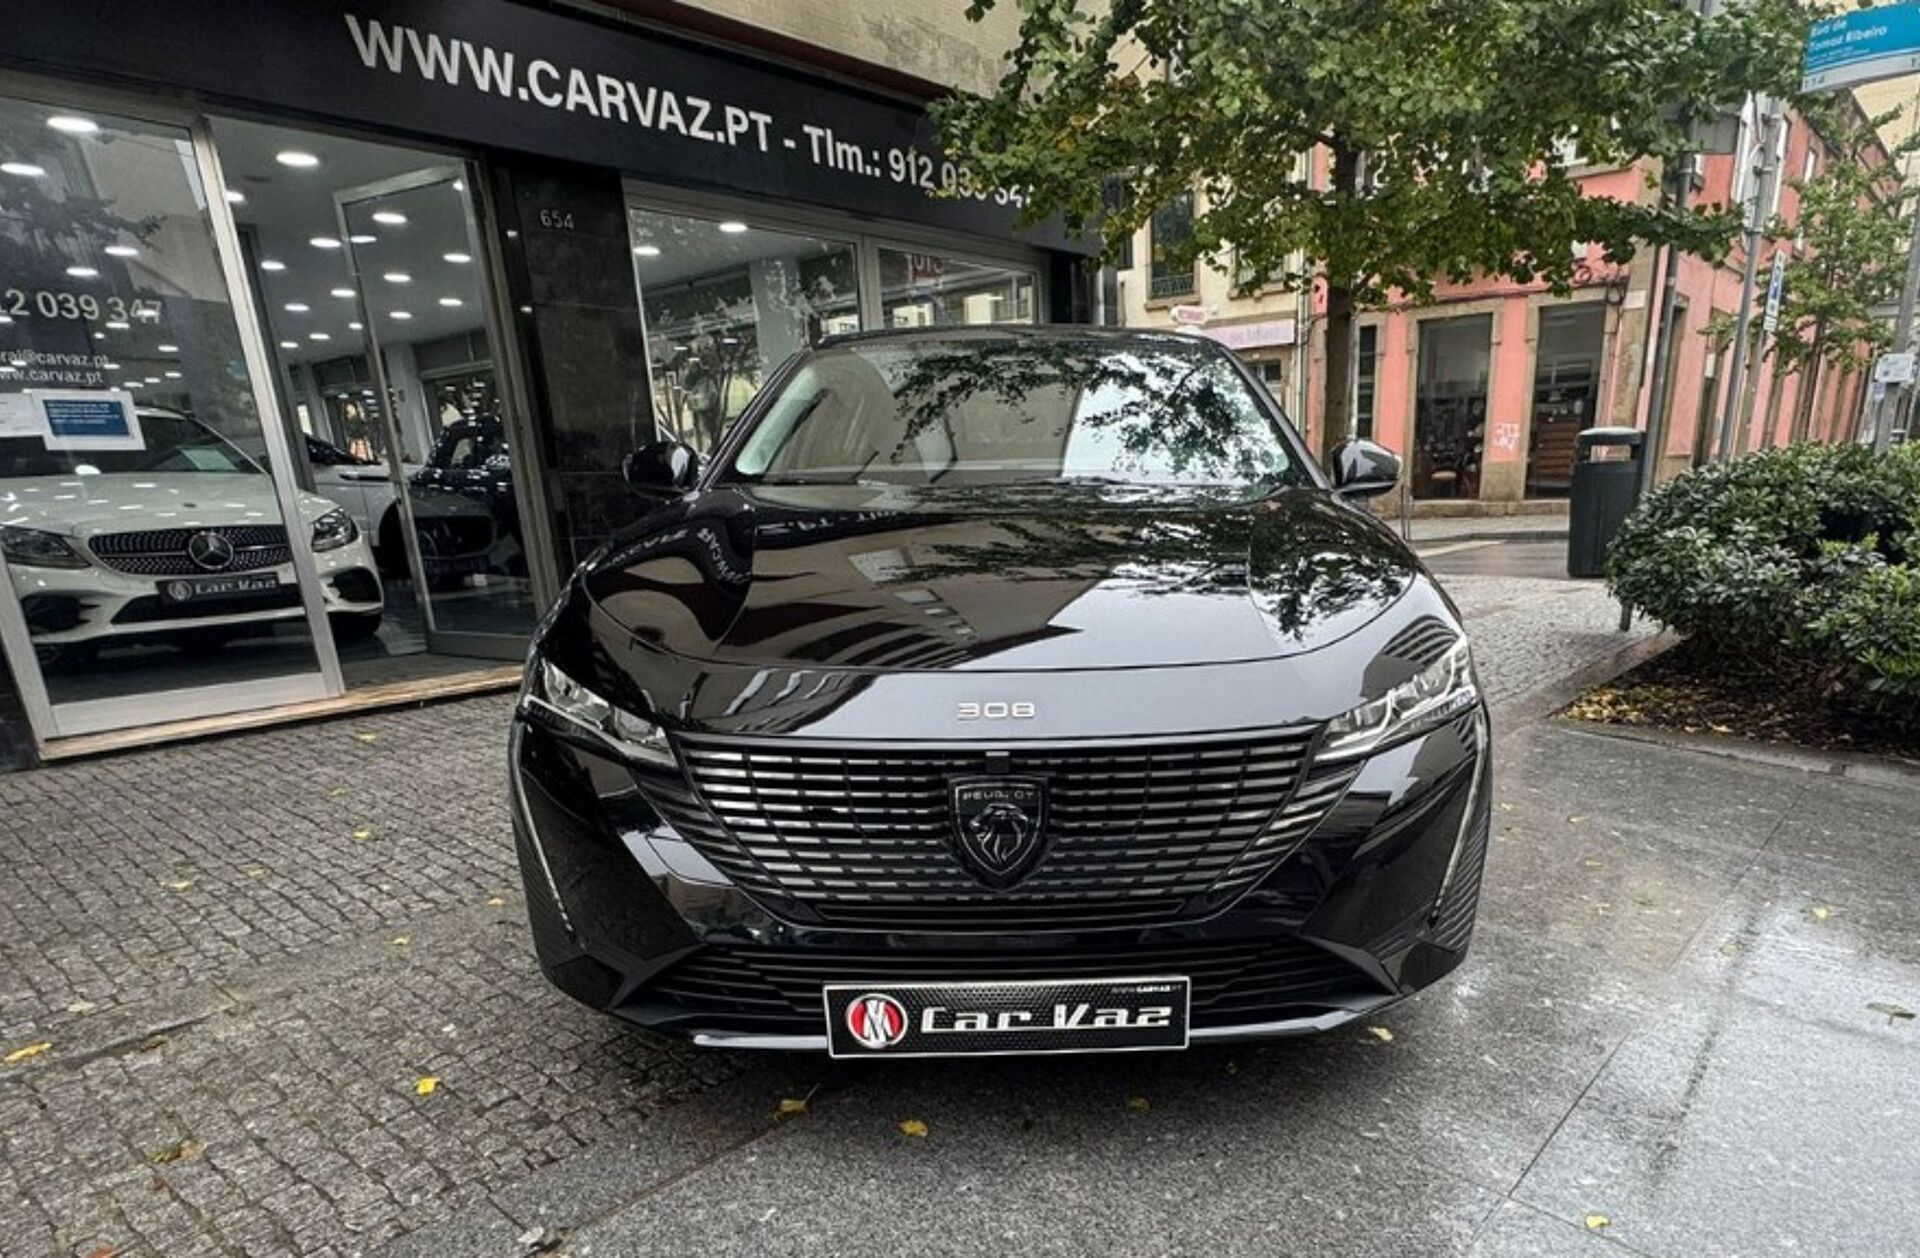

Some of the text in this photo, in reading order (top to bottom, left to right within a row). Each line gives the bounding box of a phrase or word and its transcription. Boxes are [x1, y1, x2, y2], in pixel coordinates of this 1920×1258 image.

[344, 14, 773, 152] WWW.CARVAZ.PT
[803, 124, 881, 177] Tlm.:
[889, 149, 936, 189] 912
[942, 162, 987, 200] 03
[540, 209, 575, 230] 654
[36, 291, 99, 320] 039
[107, 296, 161, 324] 347
[195, 583, 232, 594] Car
[957, 702, 1035, 719] 308
[921, 1003, 1173, 1032] Car Vaz
